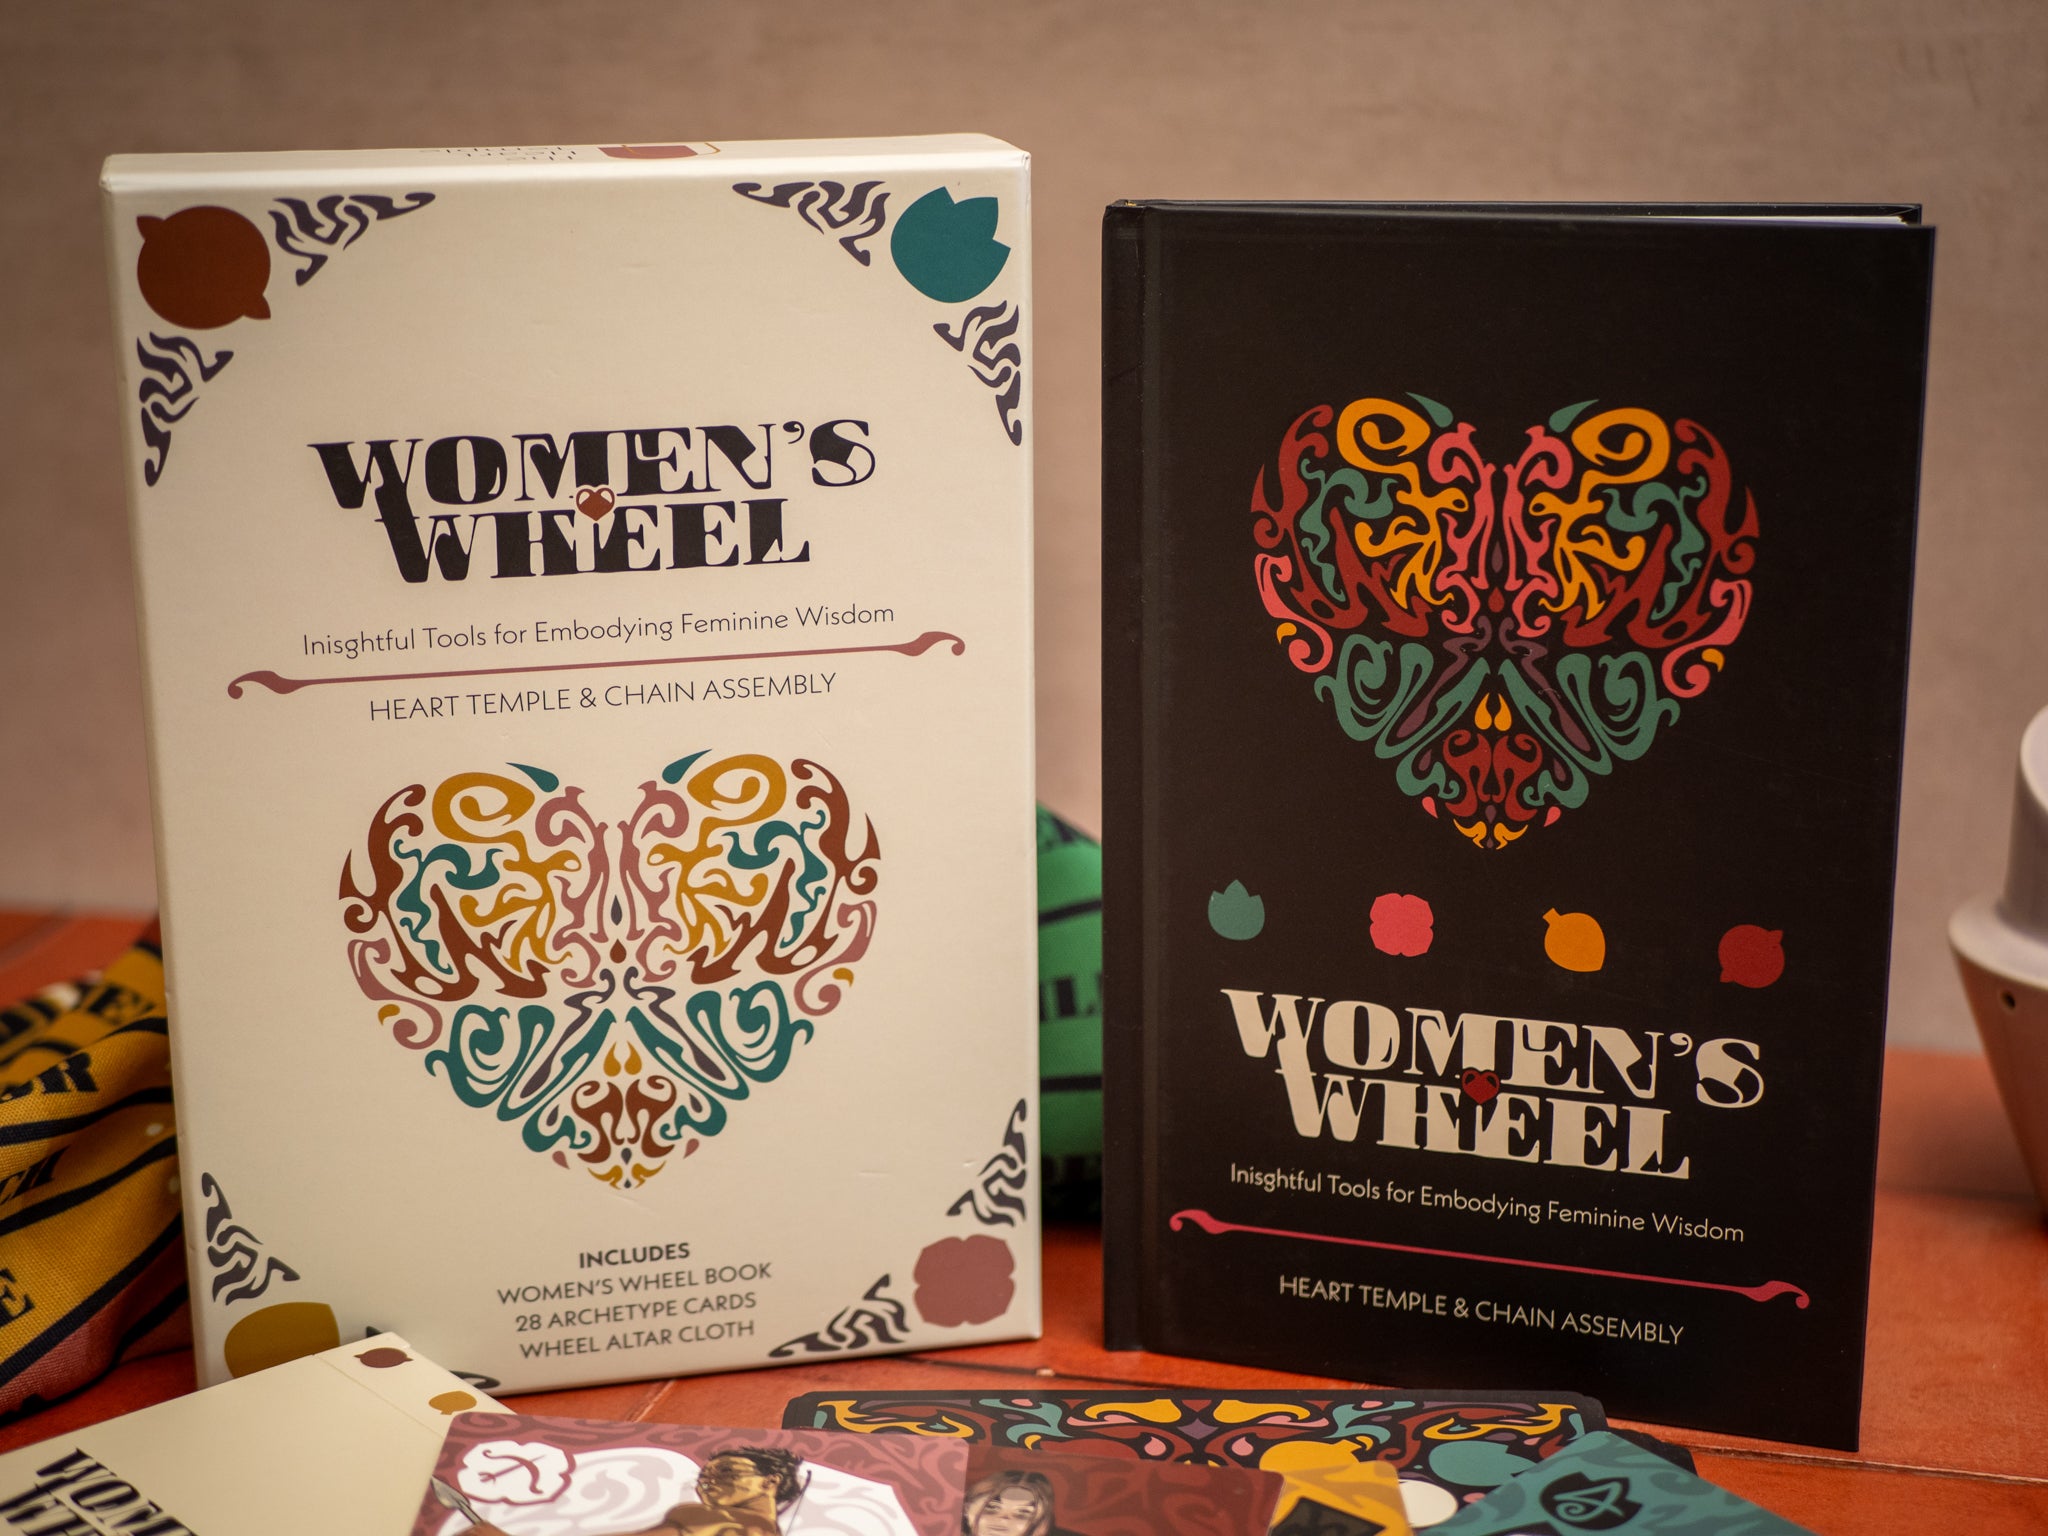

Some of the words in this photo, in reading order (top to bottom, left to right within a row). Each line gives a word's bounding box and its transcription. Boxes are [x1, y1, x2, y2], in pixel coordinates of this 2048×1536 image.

[307, 419, 876, 509] WOMEN'S
[375, 498, 811, 583] WHEEL
[303, 628, 415, 659] Inisghtful
[422, 625, 486, 649] Tools
[494, 623, 527, 645] for
[535, 616, 673, 644] Embodying
[682, 612, 788, 634] Feminine
[795, 603, 894, 627] Wisdom
[370, 696, 459, 721] HEART
[466, 689, 571, 715] TEMPLE
[579, 687, 597, 708] &
[604, 681, 694, 707] CHAIN
[703, 672, 836, 701] ASSEMBLY
[1221, 988, 1764, 1108] WOMEN'S
[1275, 1068, 1690, 1180] WHEEL
[1231, 1163, 1321, 1192] Inisghtful
[1327, 1175, 1380, 1199] Tools
[1387, 1181, 1415, 1203] for
[1421, 1186, 1541, 1224] Embodying
[1548, 1201, 1645, 1231] Feminine
[1652, 1212, 1744, 1242] Wisdom
[497, 1278, 613, 1305] WOMEN'S
[619, 1270, 699, 1293] WHEEL
[705, 1262, 772, 1285] BOOK
[579, 1242, 690, 1269] INCLUDES
[516, 1314, 541, 1332] 28
[548, 1300, 677, 1329] ARCHETYPE
[684, 1292, 756, 1314] CARDS
[520, 1337, 600, 1359] WHEEL
[606, 1329, 672, 1351] ALTAR
[679, 1320, 754, 1343] CLOTH
[1280, 1275, 1354, 1303] HEART
[1359, 1285, 1447, 1316] TEMPLE
[1453, 1297, 1469, 1319] &
[1475, 1301, 1555, 1330] CHAIN
[1561, 1312, 1684, 1345] ASSEMBLY
